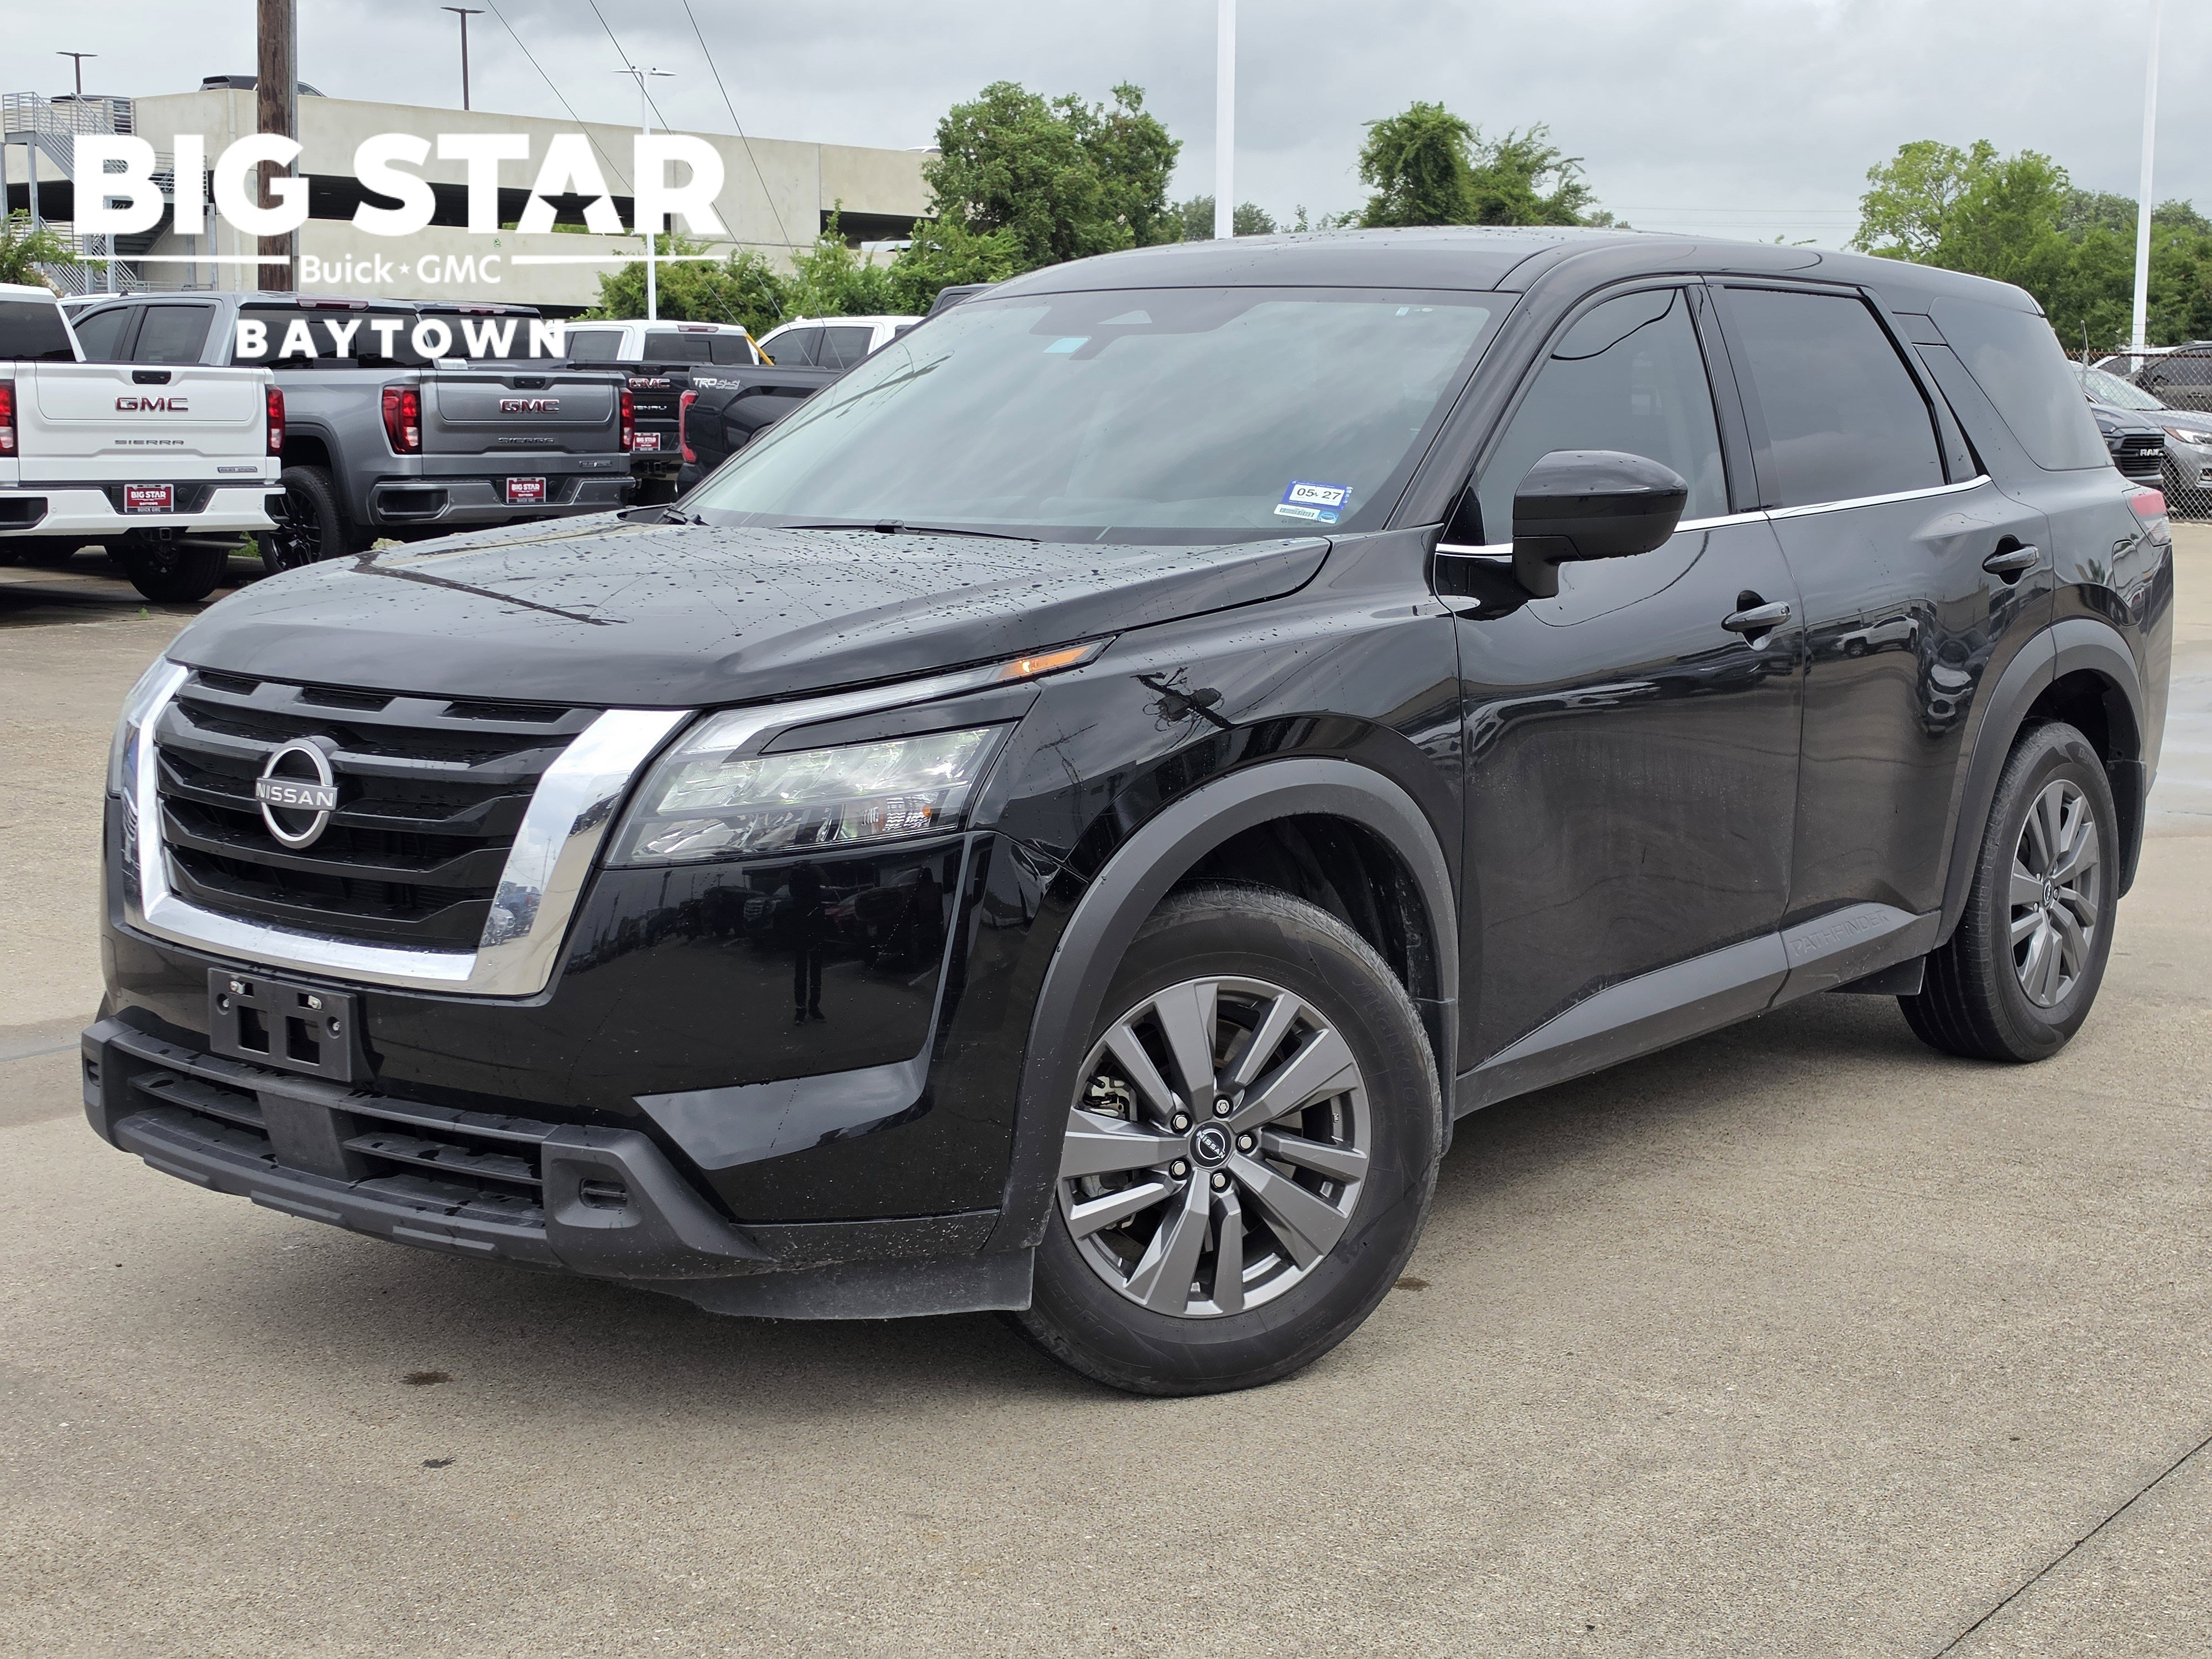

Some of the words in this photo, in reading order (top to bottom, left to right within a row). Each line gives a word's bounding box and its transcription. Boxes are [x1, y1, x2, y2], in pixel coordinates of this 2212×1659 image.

[629, 378, 670, 389] GMC
[693, 378, 717, 389] TRD
[115, 395, 189, 412] GMC
[499, 399, 560, 413] GMC
[1321, 491, 1342, 500] 27
[255, 782, 333, 807] NISSAN
[1790, 910, 1890, 957] PATHFINDER
[1196, 1130, 1225, 1159] NISSAN
